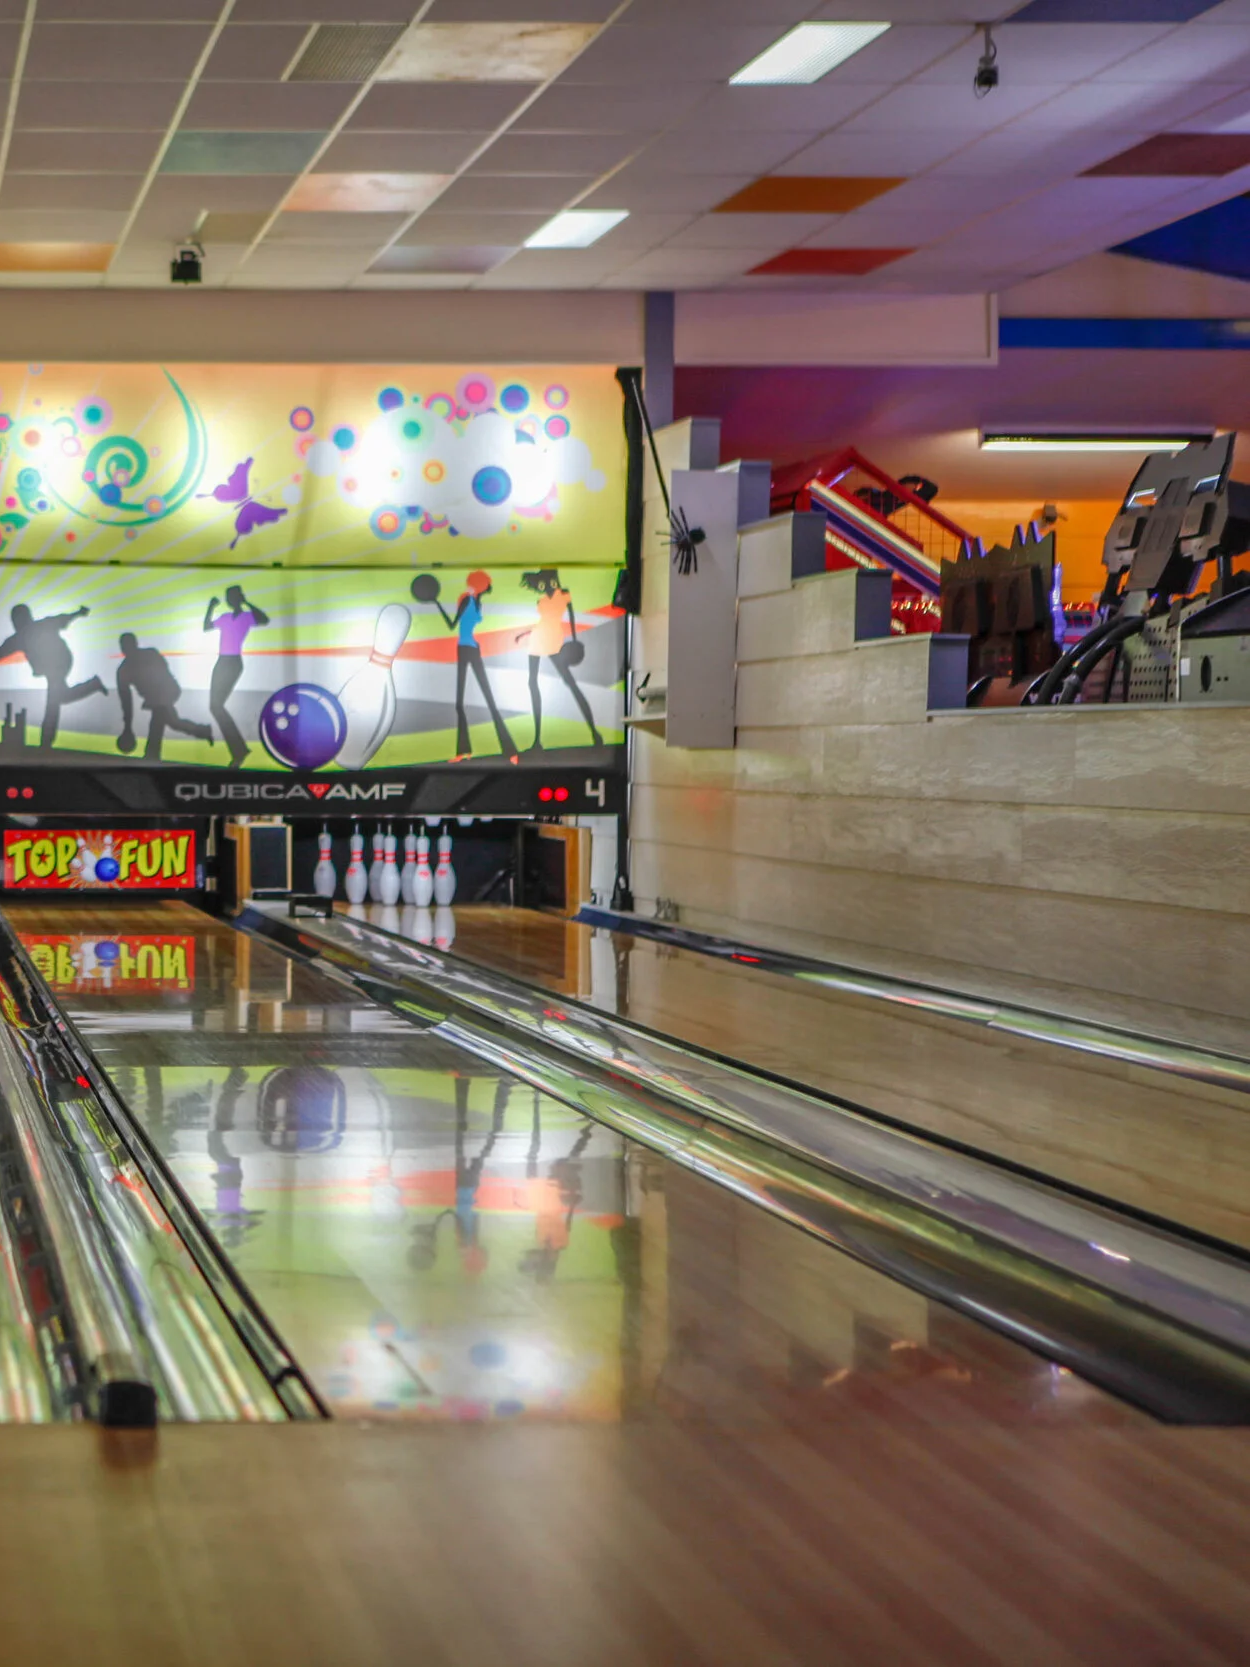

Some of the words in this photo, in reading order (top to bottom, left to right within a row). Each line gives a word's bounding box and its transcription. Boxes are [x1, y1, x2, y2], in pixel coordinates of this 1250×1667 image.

[174, 783, 310, 801] QUBICA
[325, 783, 407, 800] AMF
[585, 778, 605, 807] 4
[6, 835, 78, 884] TOP
[119, 834, 191, 881] FUN
